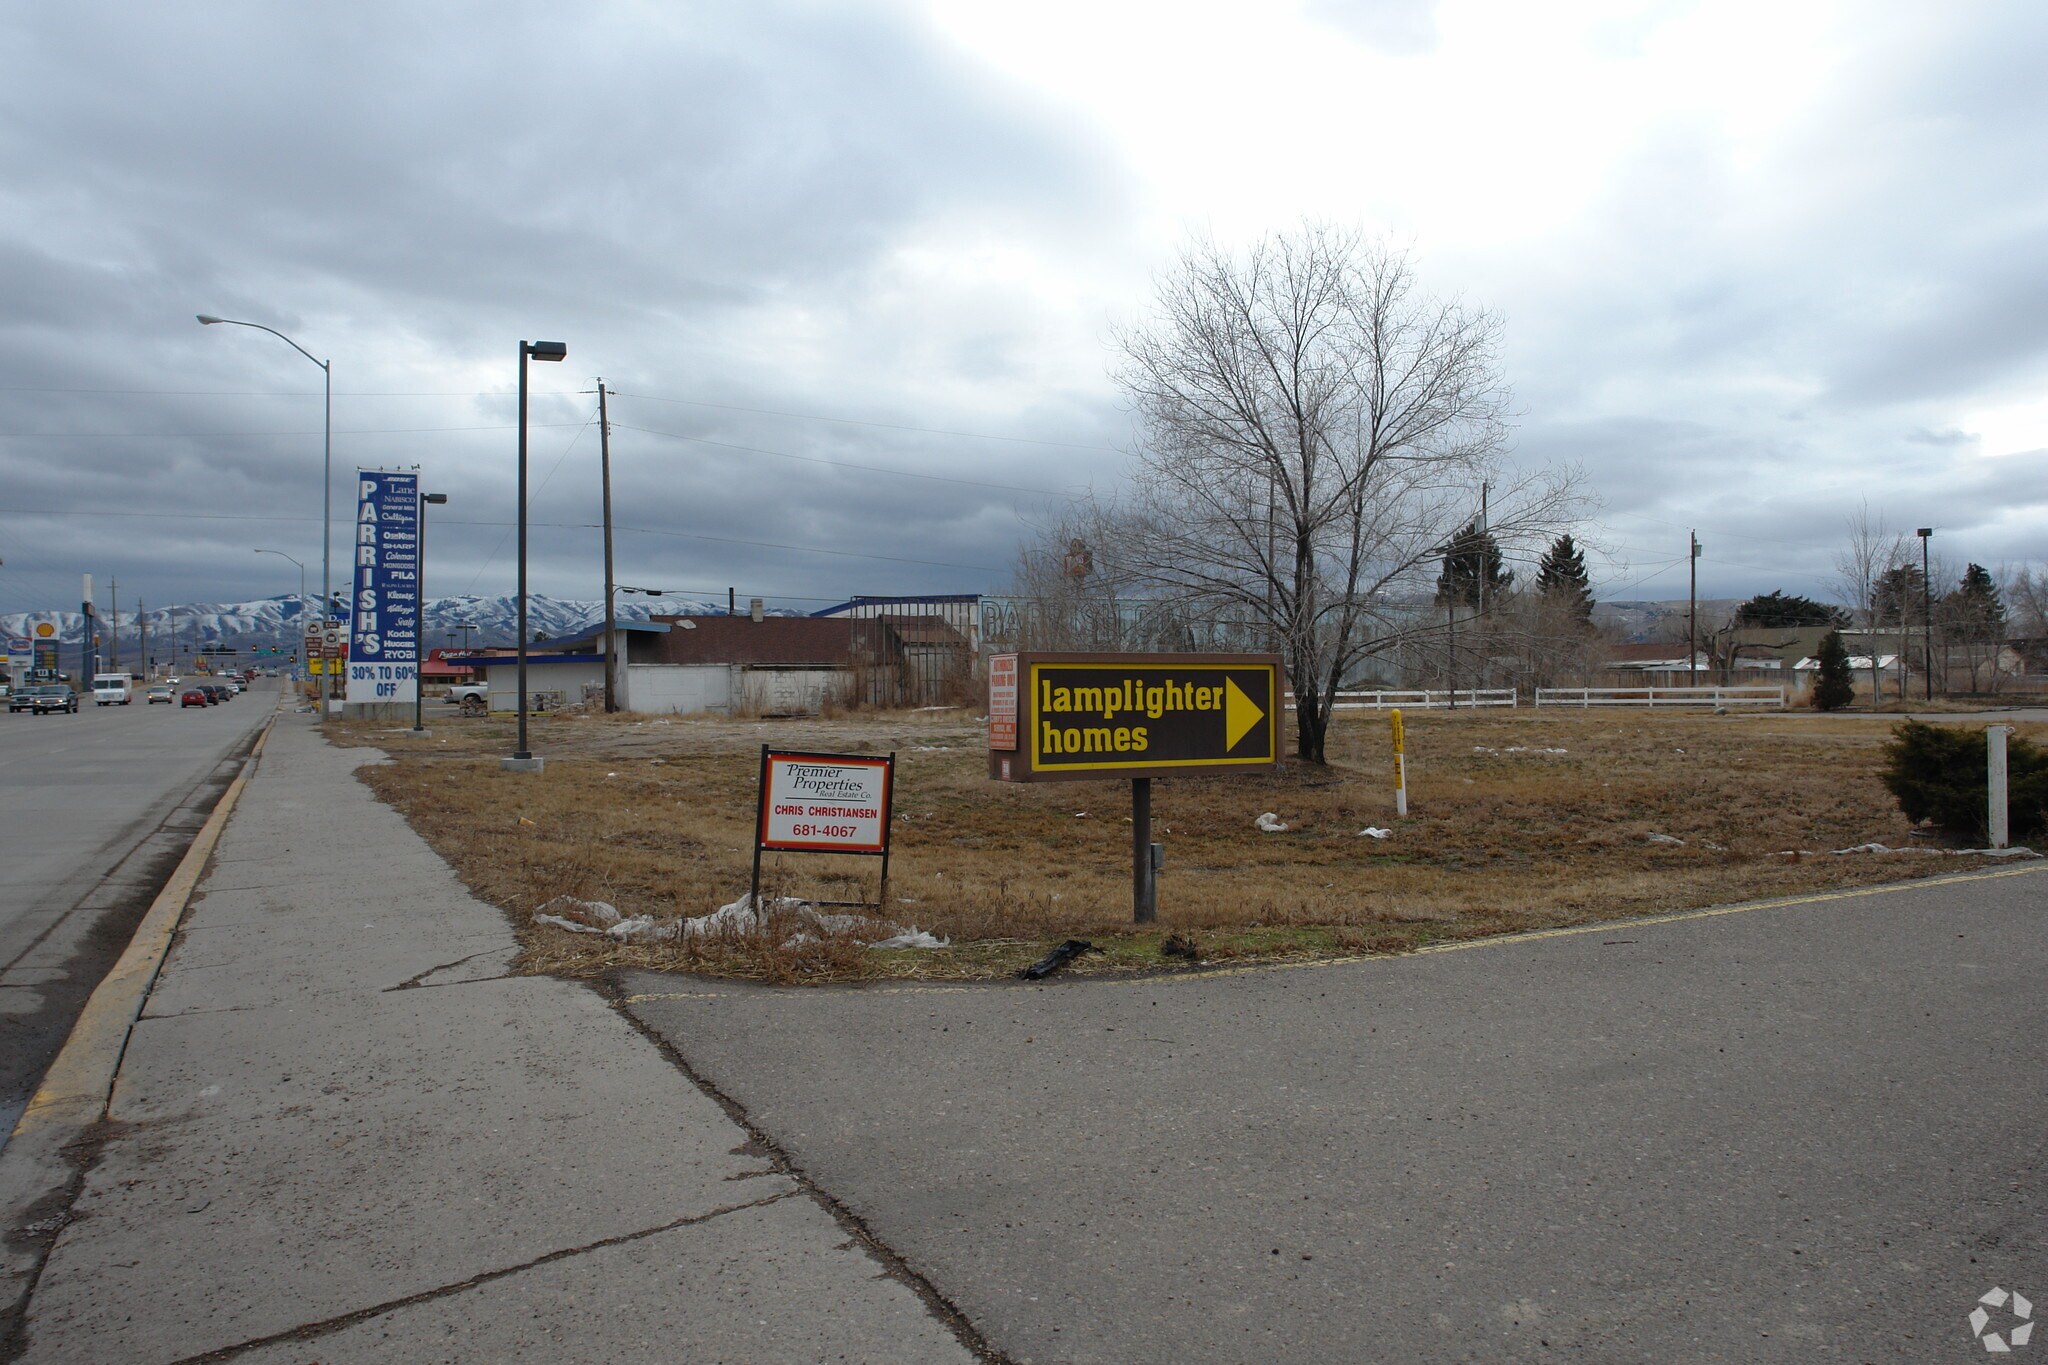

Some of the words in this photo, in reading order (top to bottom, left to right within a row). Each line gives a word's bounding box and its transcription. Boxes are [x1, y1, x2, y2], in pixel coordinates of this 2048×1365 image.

[391, 484, 415, 494] Lane
[382, 512, 415, 524] Culligan
[386, 551, 415, 560] Coleman
[391, 571, 415, 580] FILA
[395, 617, 415, 628] Sealy
[387, 630, 415, 638] Kodak
[384, 650, 415, 659] RYOBI
[352, 666, 376, 680] 30%
[378, 666, 392, 680] TO
[395, 666, 417, 680] 60%
[376, 683, 396, 696] OFF
[1042, 679, 1223, 719] lamplighter
[1042, 721, 1148, 753] homes
[787, 764, 843, 777] Premier
[792, 777, 863, 793] Properties
[860, 791, 872, 799] Co.
[775, 804, 804, 816] CHRIS
[808, 806, 878, 819] CHRISTIANSEN
[792, 824, 857, 838] 681-4067
